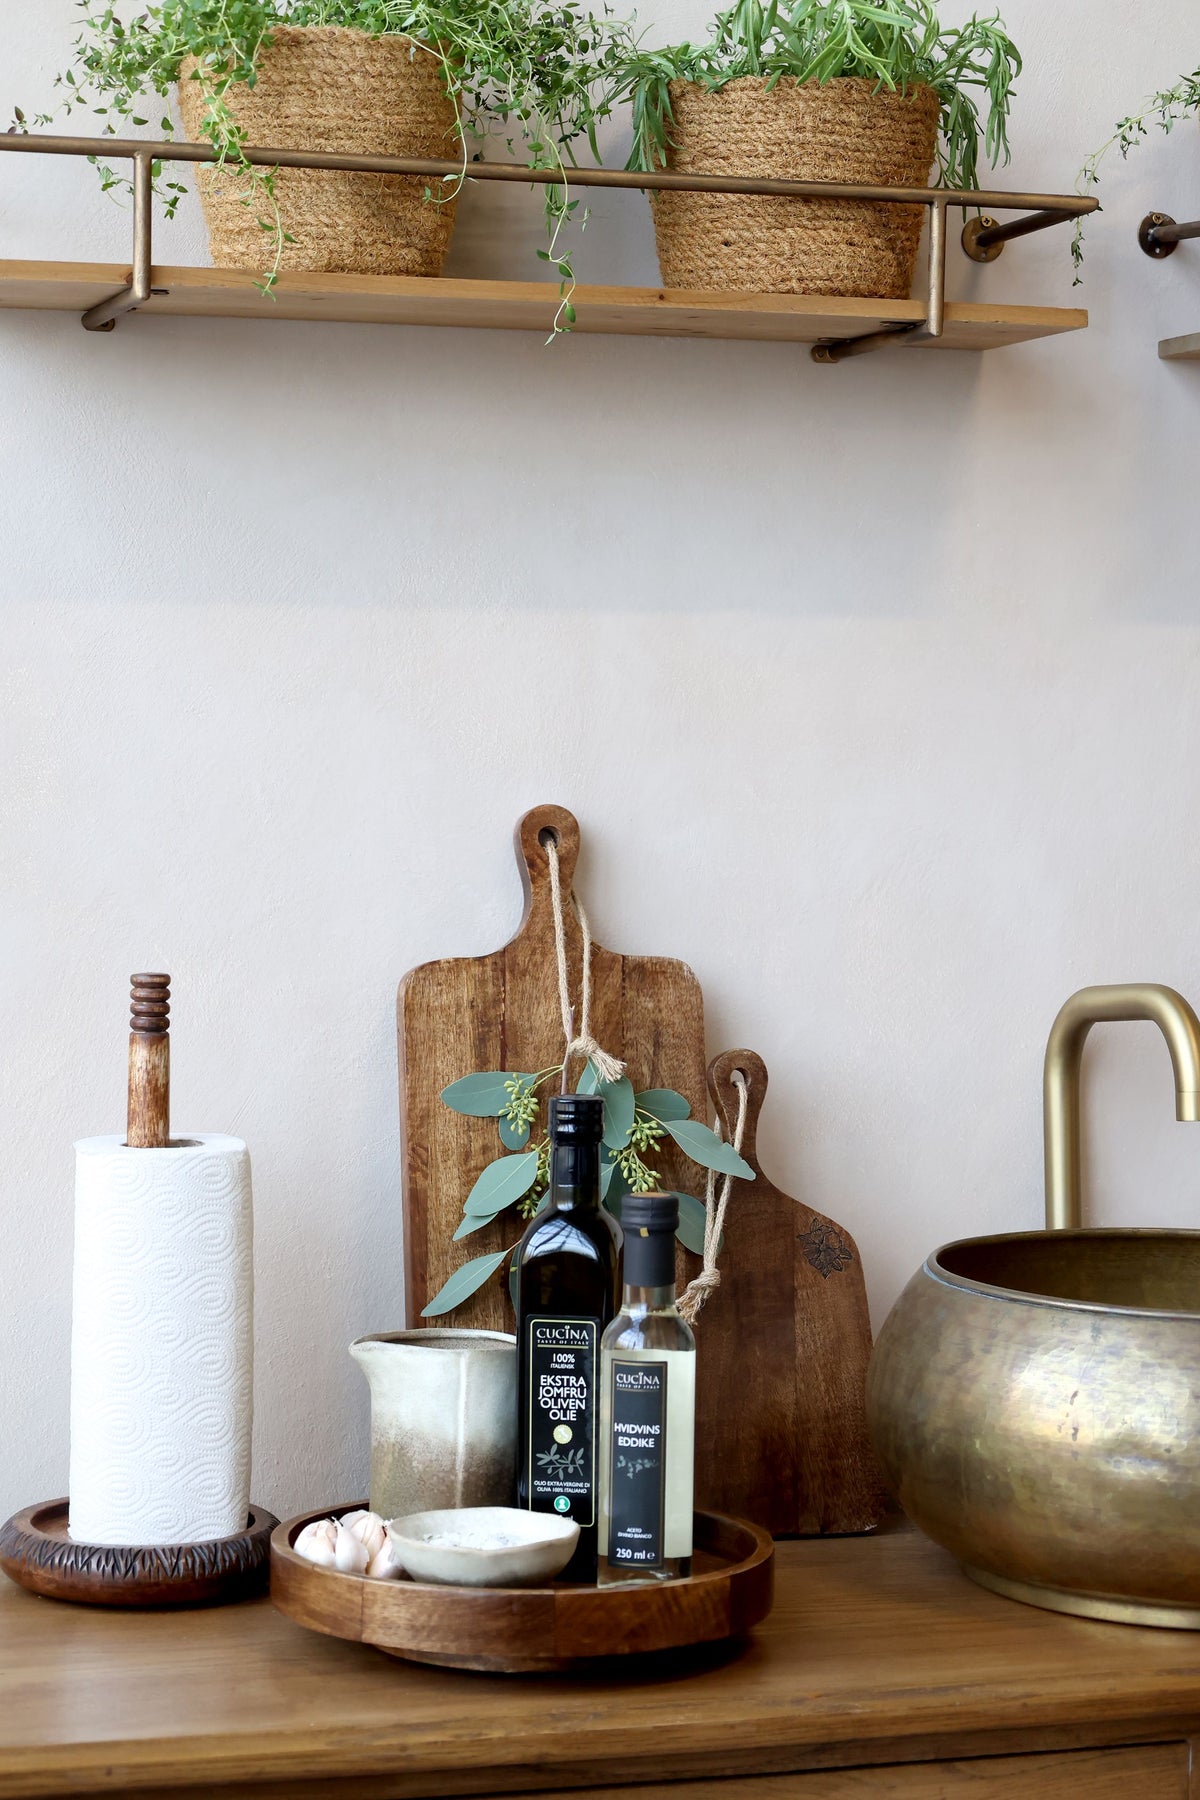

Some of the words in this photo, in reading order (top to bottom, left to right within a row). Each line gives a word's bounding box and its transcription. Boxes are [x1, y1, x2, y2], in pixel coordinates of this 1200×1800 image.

[552, 1353, 575, 1363] 100%
[540, 1375, 587, 1387] EKSTRA
[537, 1386, 587, 1400] JOMFRU
[540, 1398, 586, 1410] OLIVEN
[549, 1409, 577, 1421] OLIE
[614, 1422, 660, 1435] HVIDVINS
[618, 1436, 655, 1448] EDDIKE
[616, 1547, 632, 1559] 250
[633, 1550, 646, 1560] ml
